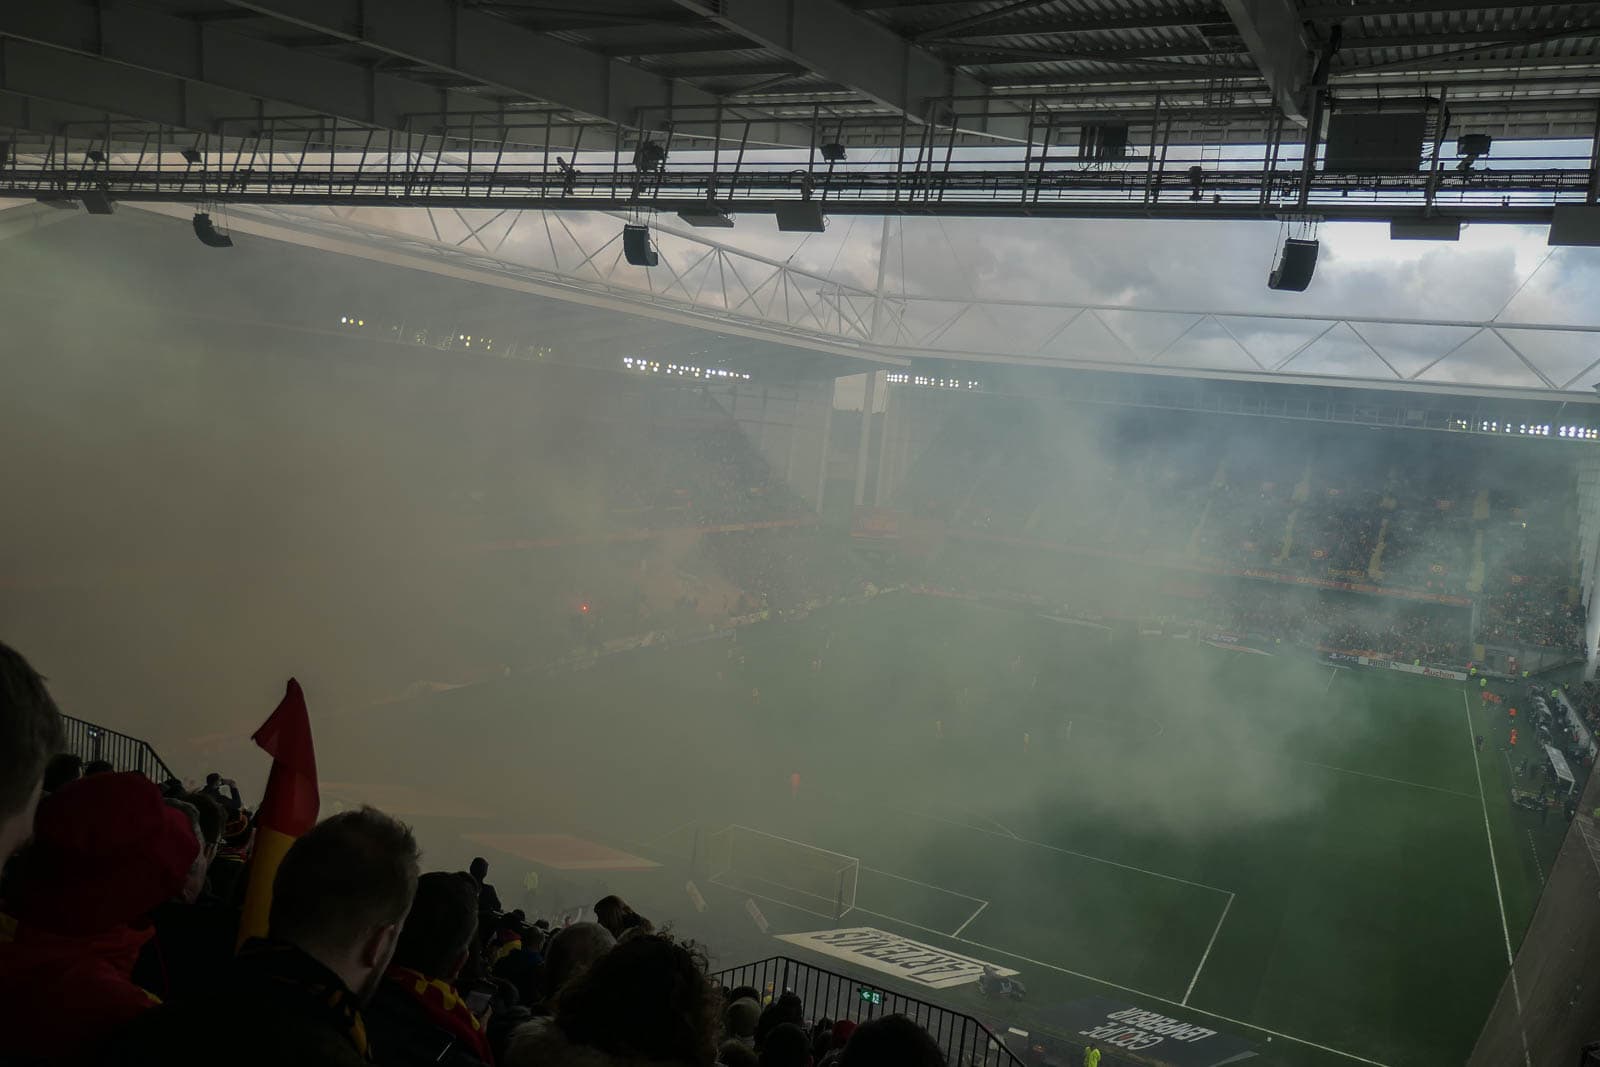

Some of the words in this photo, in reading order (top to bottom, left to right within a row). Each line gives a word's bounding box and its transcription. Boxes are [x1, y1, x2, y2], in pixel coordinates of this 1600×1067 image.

[810, 931, 977, 976] ARTEMIS
[1078, 1021, 1164, 1050] GROUPE
[1106, 1007, 1218, 1043] LEMPEREUR
